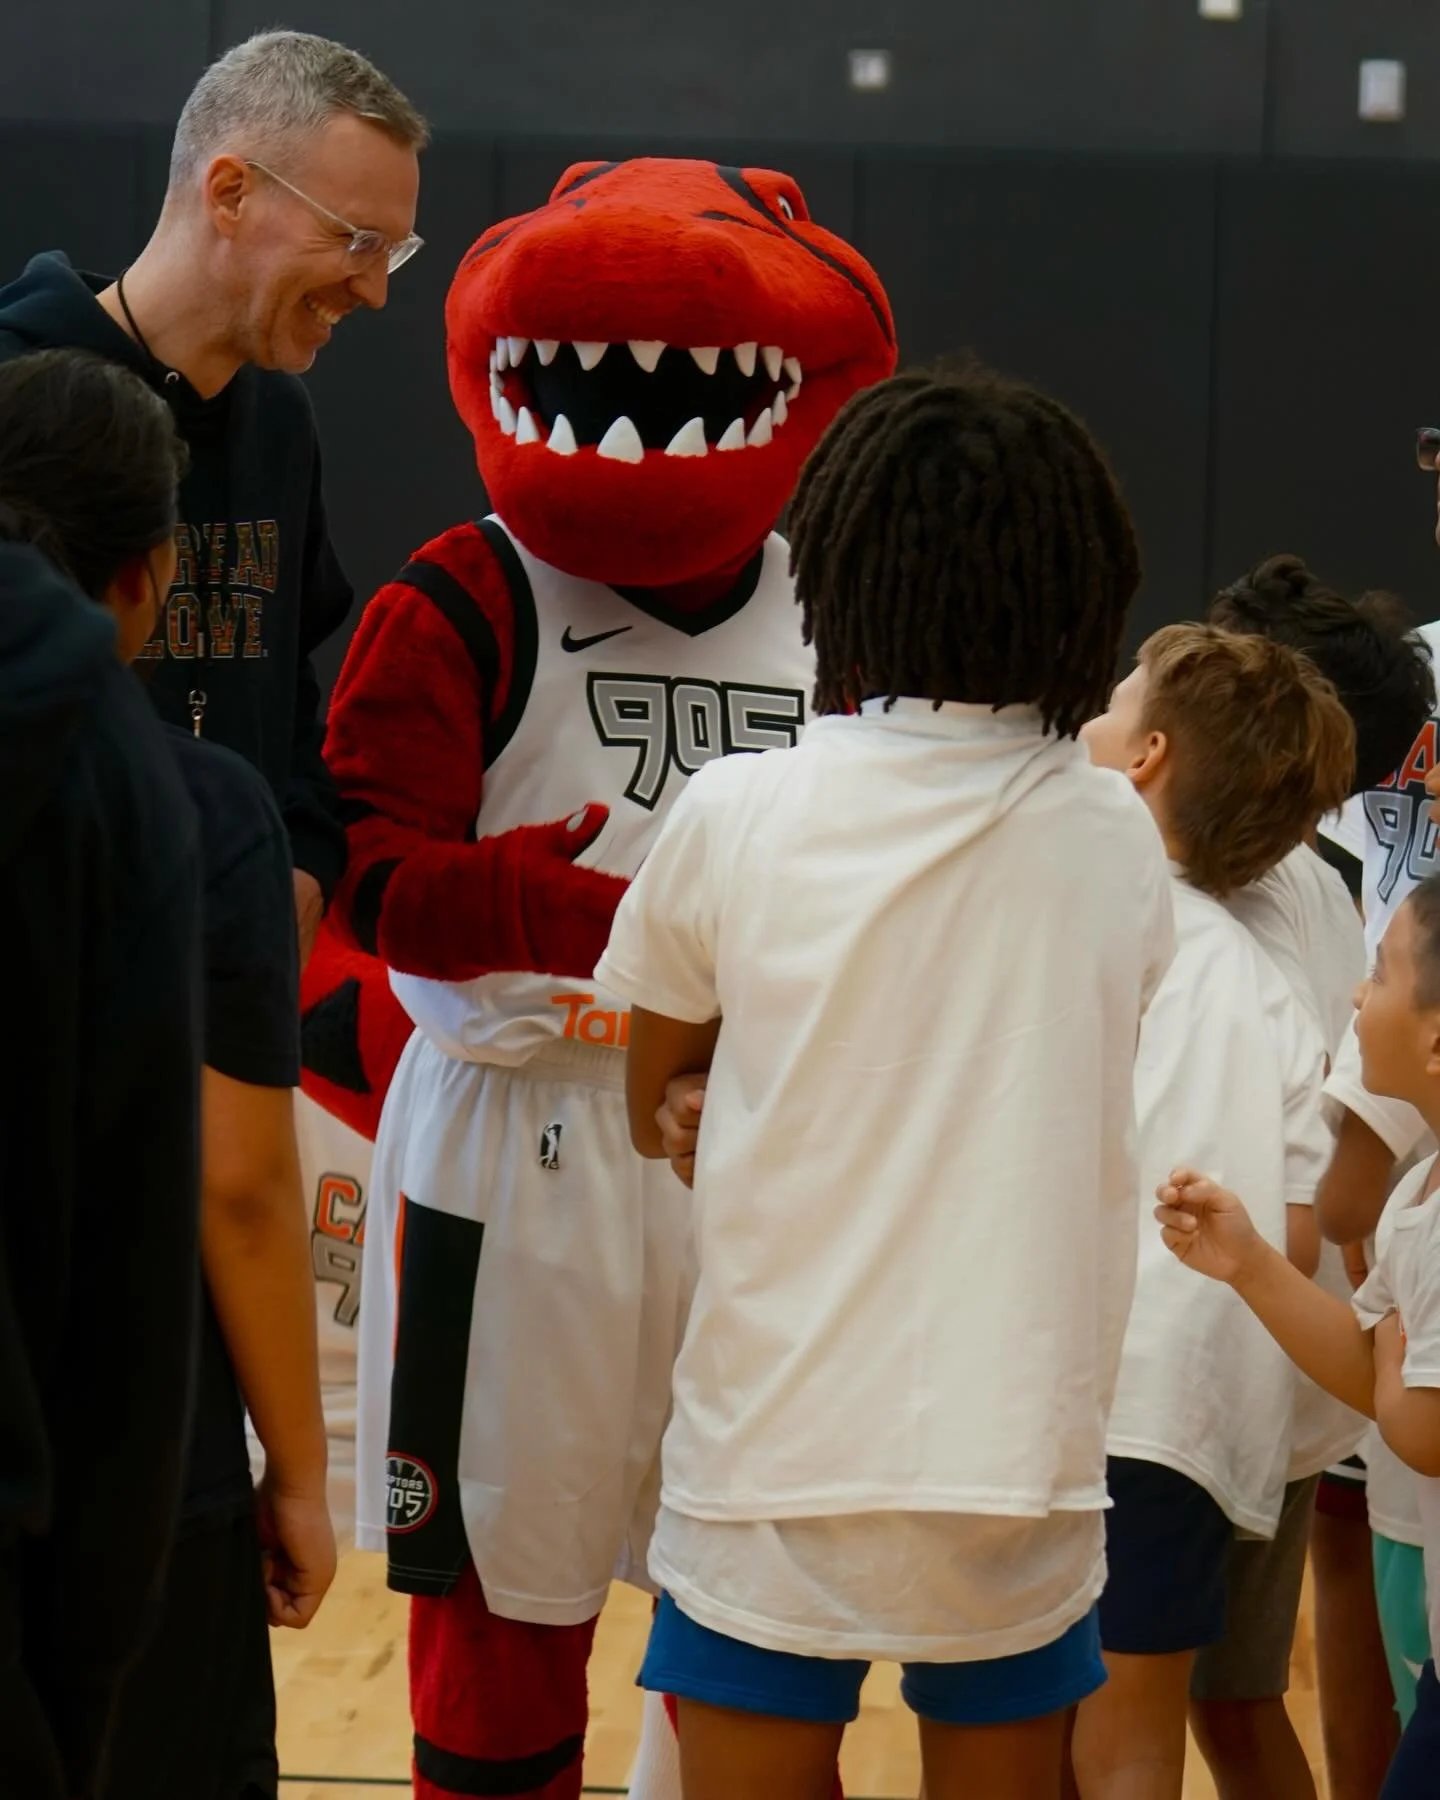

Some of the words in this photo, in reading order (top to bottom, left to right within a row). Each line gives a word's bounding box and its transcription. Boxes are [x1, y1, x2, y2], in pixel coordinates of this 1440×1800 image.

[586, 671, 805, 811] 905
[551, 993, 632, 1047] Ta
[313, 1172, 368, 1245] C
